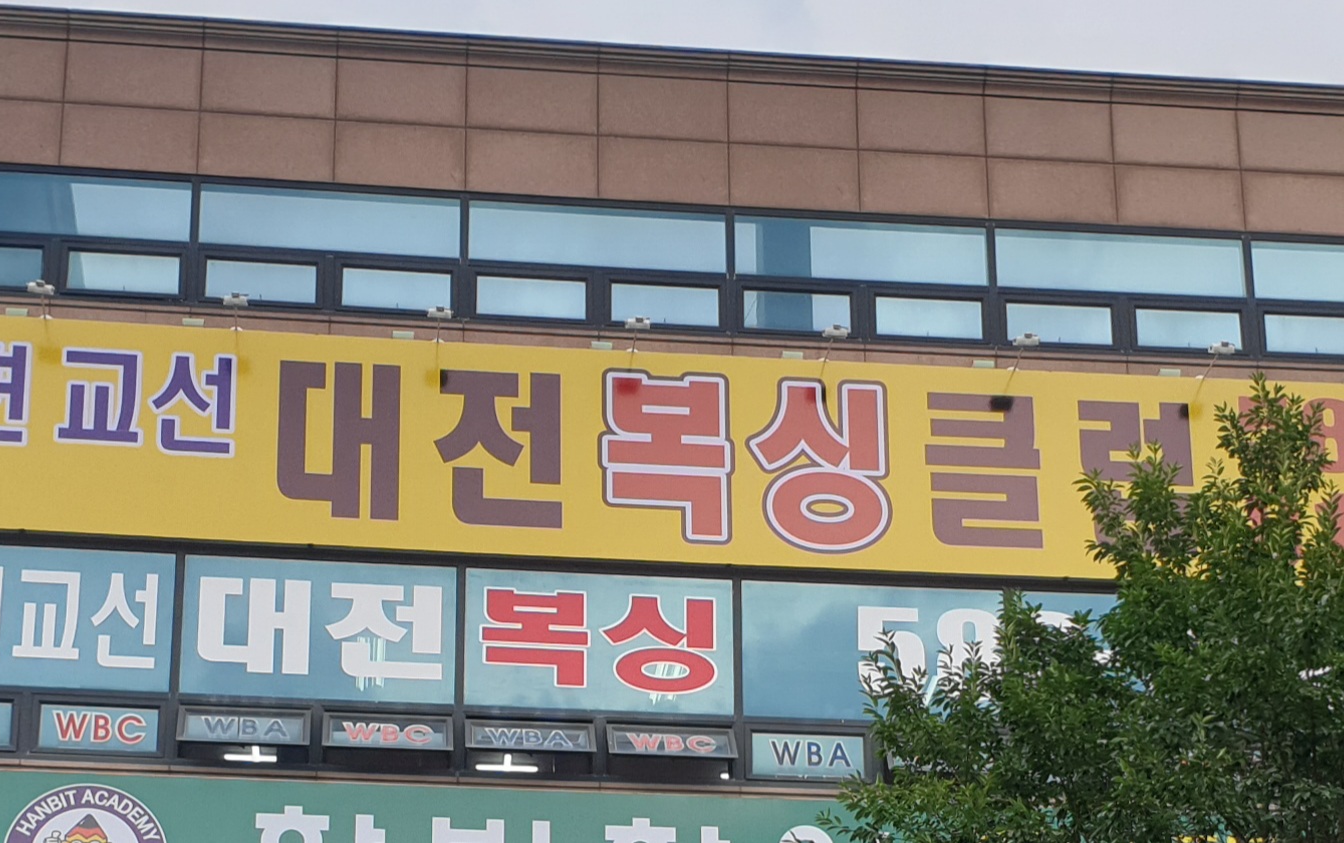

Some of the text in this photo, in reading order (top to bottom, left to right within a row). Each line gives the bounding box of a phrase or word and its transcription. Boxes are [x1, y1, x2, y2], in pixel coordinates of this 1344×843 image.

[276, 359, 564, 530] 대전
[598, 367, 893, 554] 복싱
[197, 575, 444, 681] 대전
[479, 587, 718, 694] 복싱
[52, 709, 148, 745] WBC
[200, 714, 289, 740] WBA
[342, 720, 434, 744] WBC
[484, 727, 574, 749] WBA
[624, 732, 718, 754] WBC
[768, 738, 854, 769] WBA
[14, 788, 162, 842] HANBIT ACADEMY
